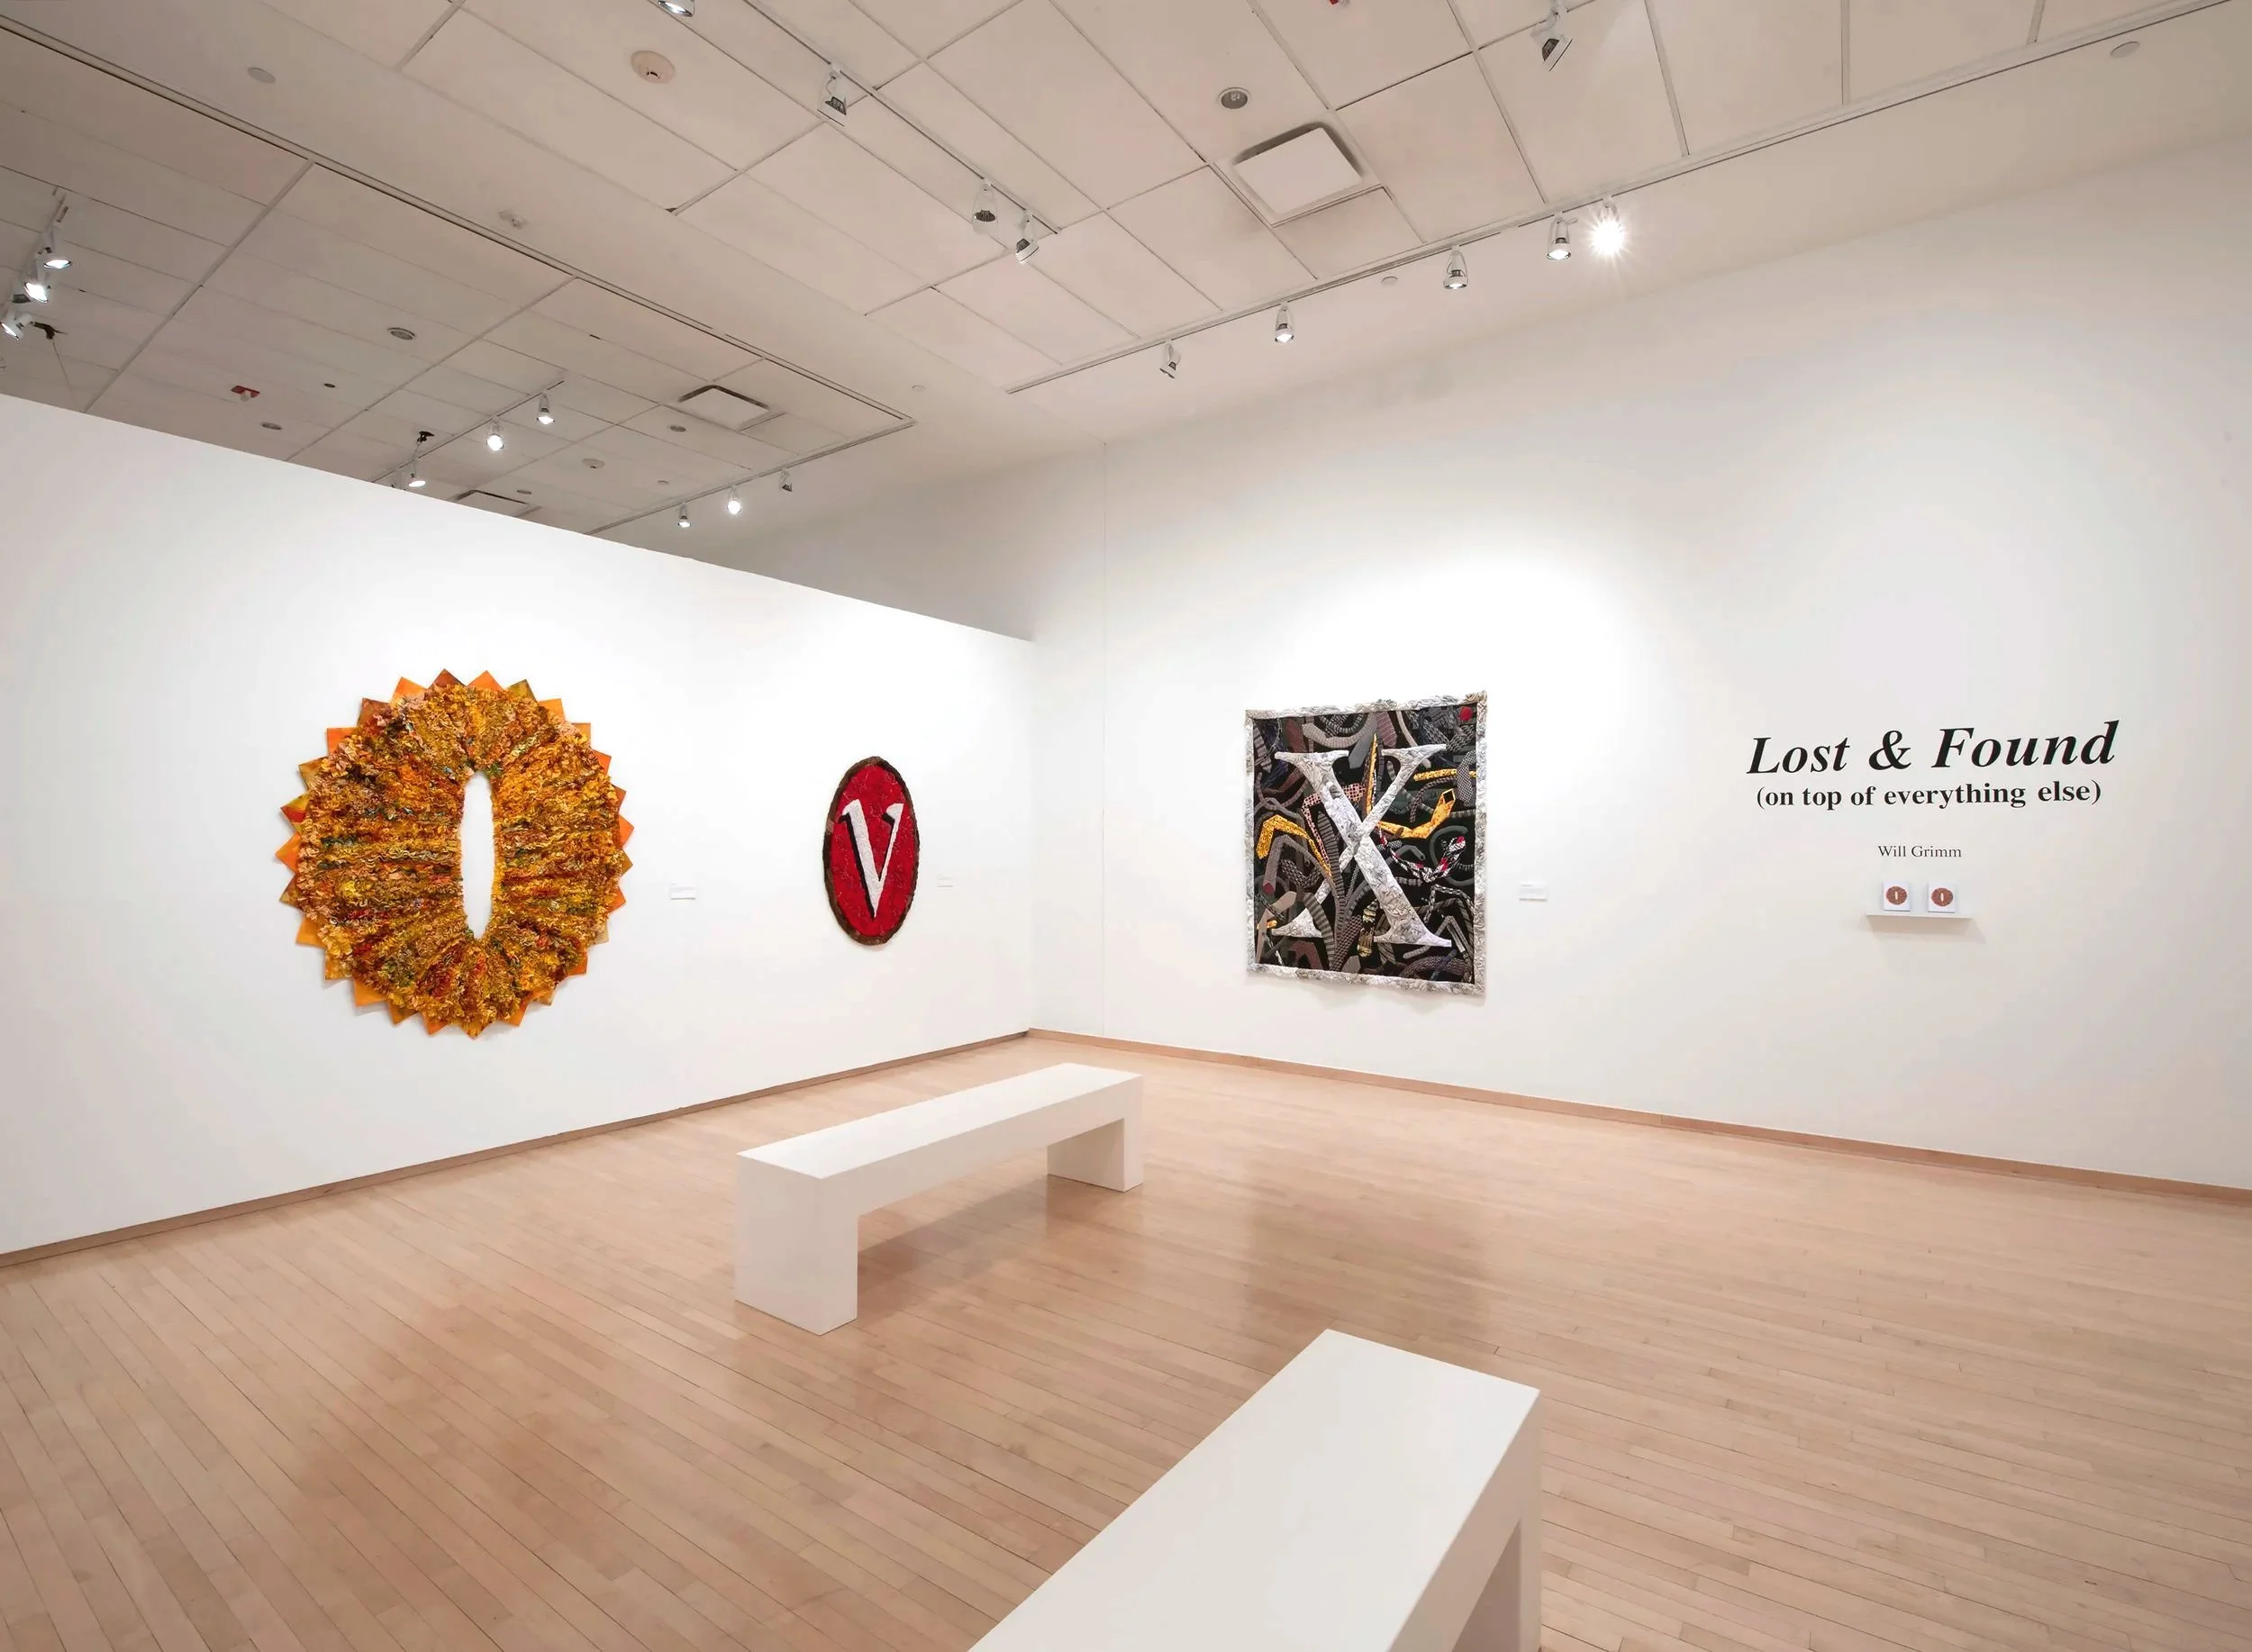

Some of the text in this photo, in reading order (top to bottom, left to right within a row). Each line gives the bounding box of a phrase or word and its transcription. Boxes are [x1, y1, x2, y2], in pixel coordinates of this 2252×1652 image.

[1746, 719, 2120, 775] Lost & Found
[1757, 779, 2102, 811] (on top of everything else)
[839, 799, 904, 921] V
[1877, 845, 1962, 858] Will Grimm
